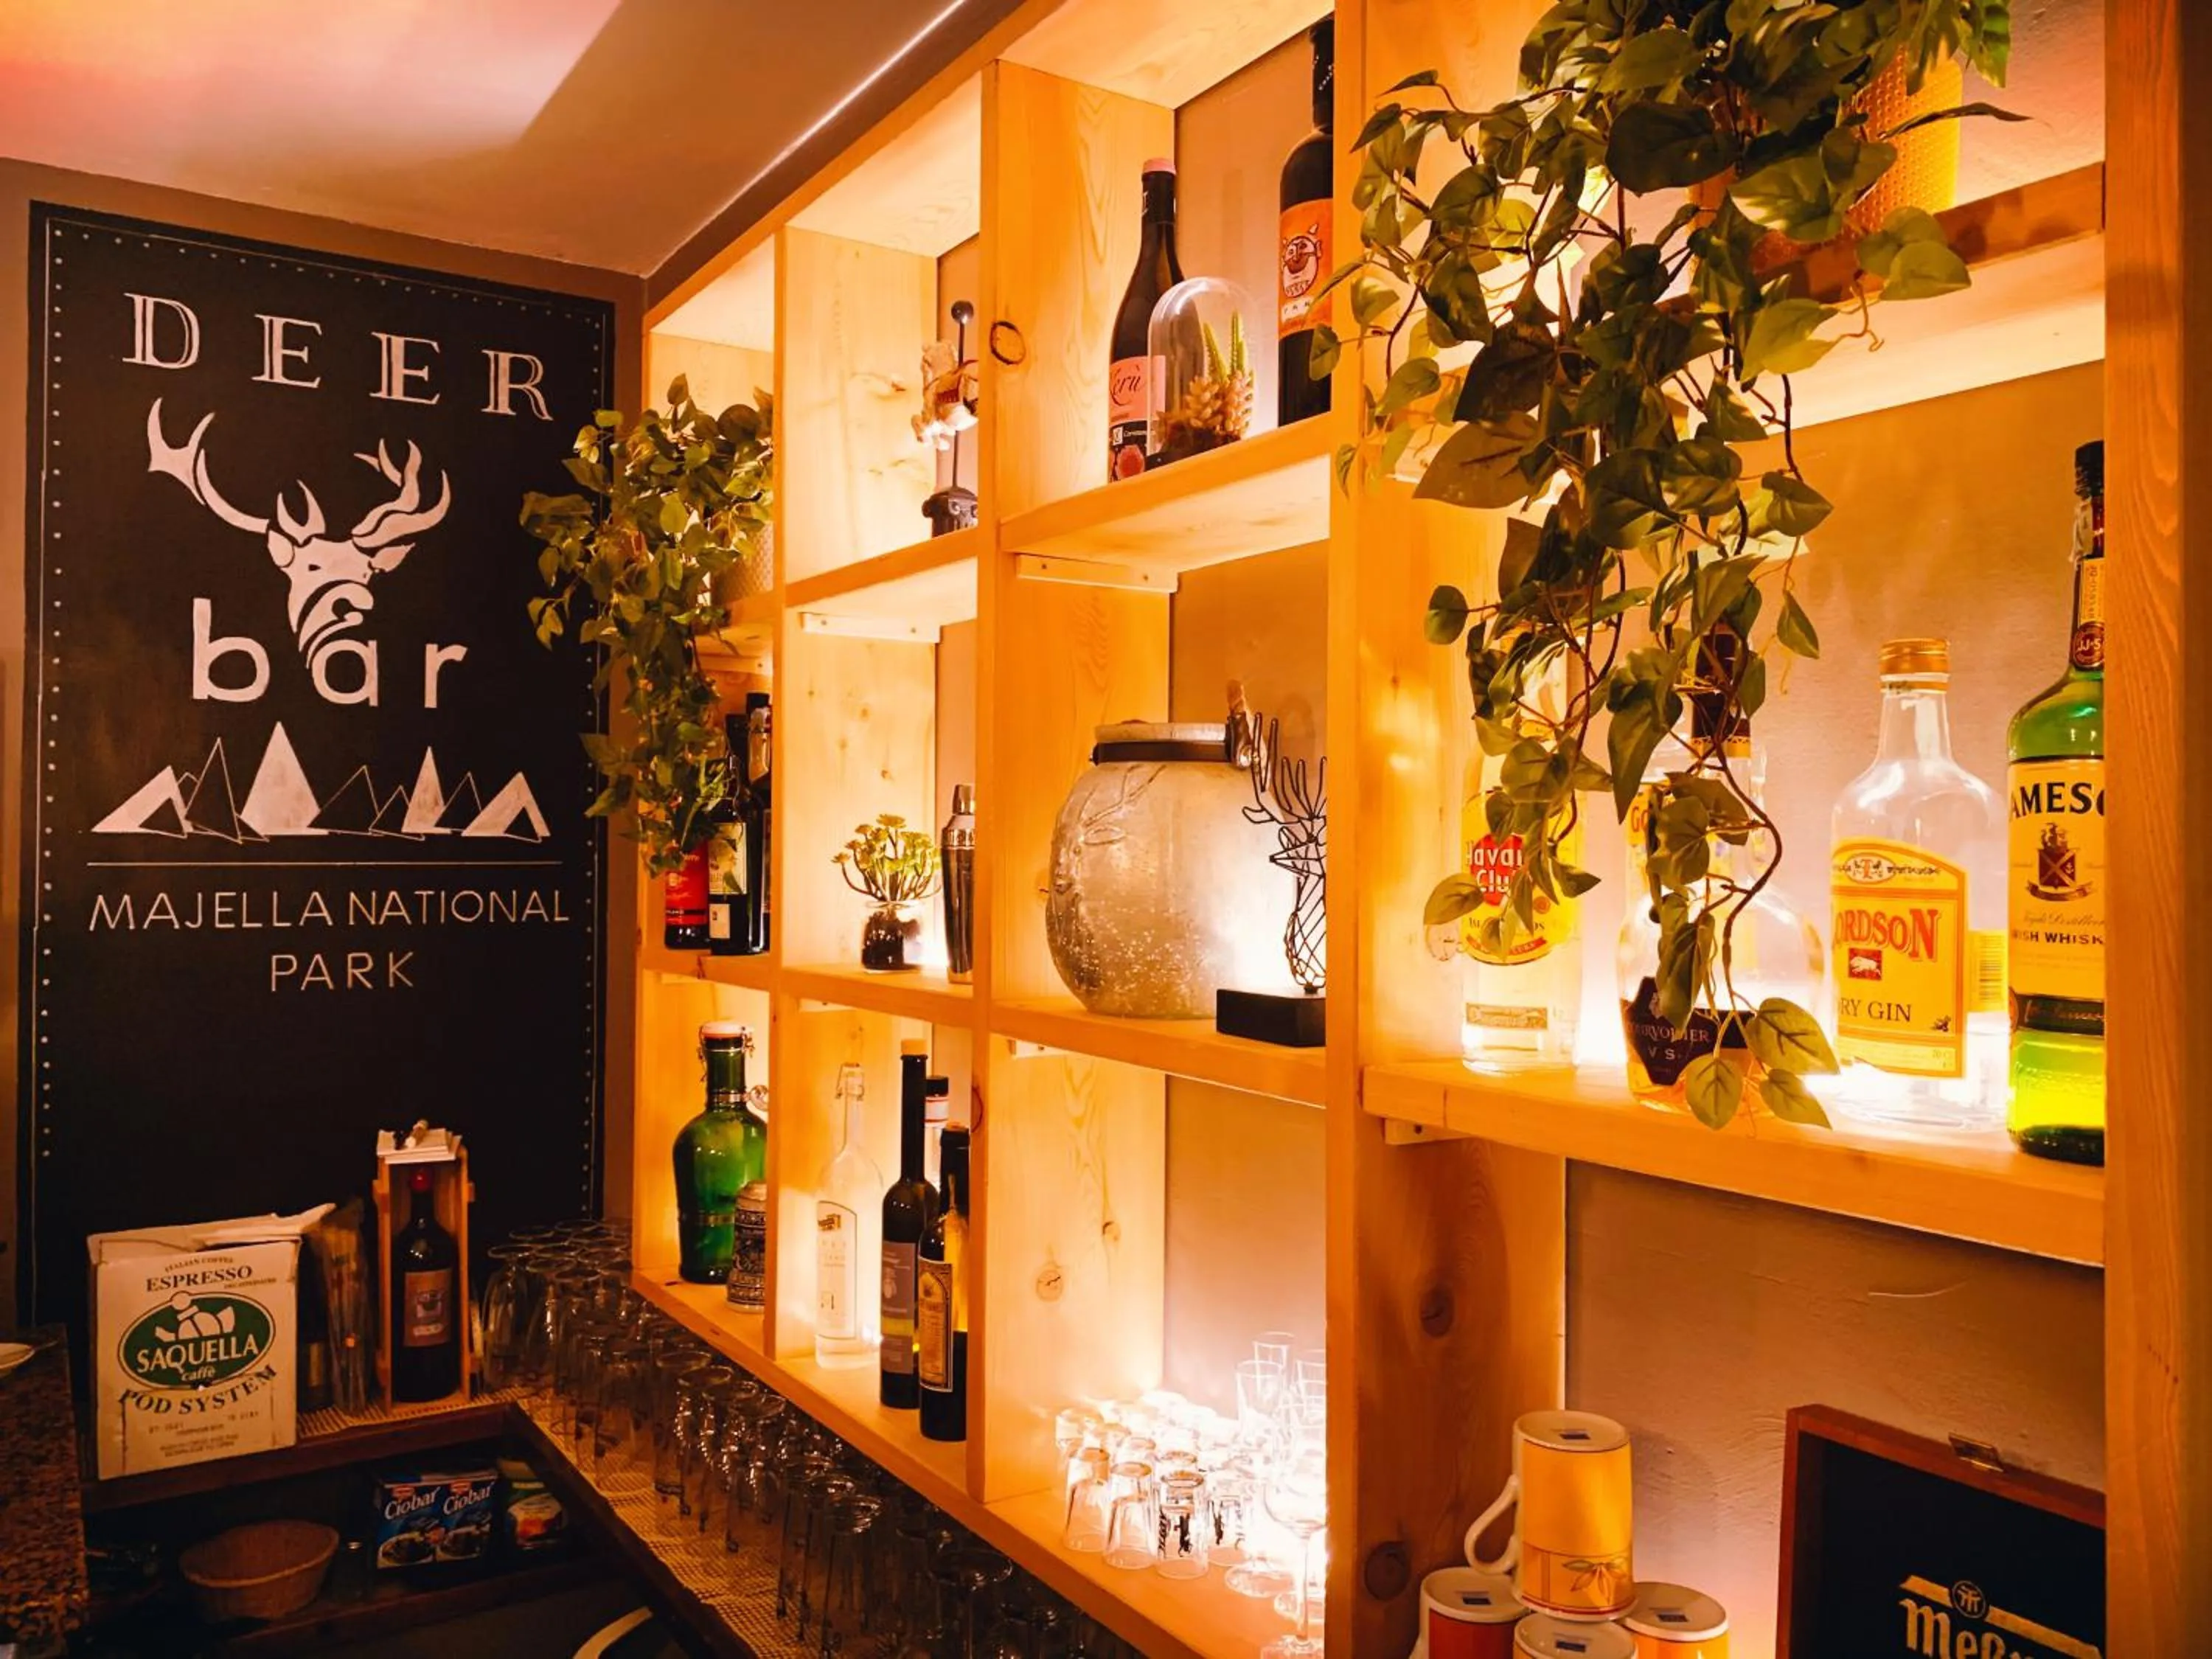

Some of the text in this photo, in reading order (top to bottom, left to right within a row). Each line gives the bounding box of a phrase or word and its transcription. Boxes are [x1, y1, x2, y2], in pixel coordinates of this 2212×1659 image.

[122, 293, 553, 421] DEER
[192, 598, 468, 709] bar
[2009, 782, 2105, 821] AMES
[1476, 869, 1512, 893] Clu
[88, 889, 570, 931] MAJELLA NATIONAL
[2045, 932, 2104, 945] WHISK
[270, 952, 414, 992] PARK
[1839, 996, 1912, 1023] RY GIN
[146, 1265, 253, 1293] ESPRESSO
[136, 1333, 259, 1374] SAQUELLA
[181, 1365, 217, 1382] caffè
[119, 1364, 277, 1416] POD SYSTEM
[384, 1481, 495, 1521] Ciobar Ciobar
